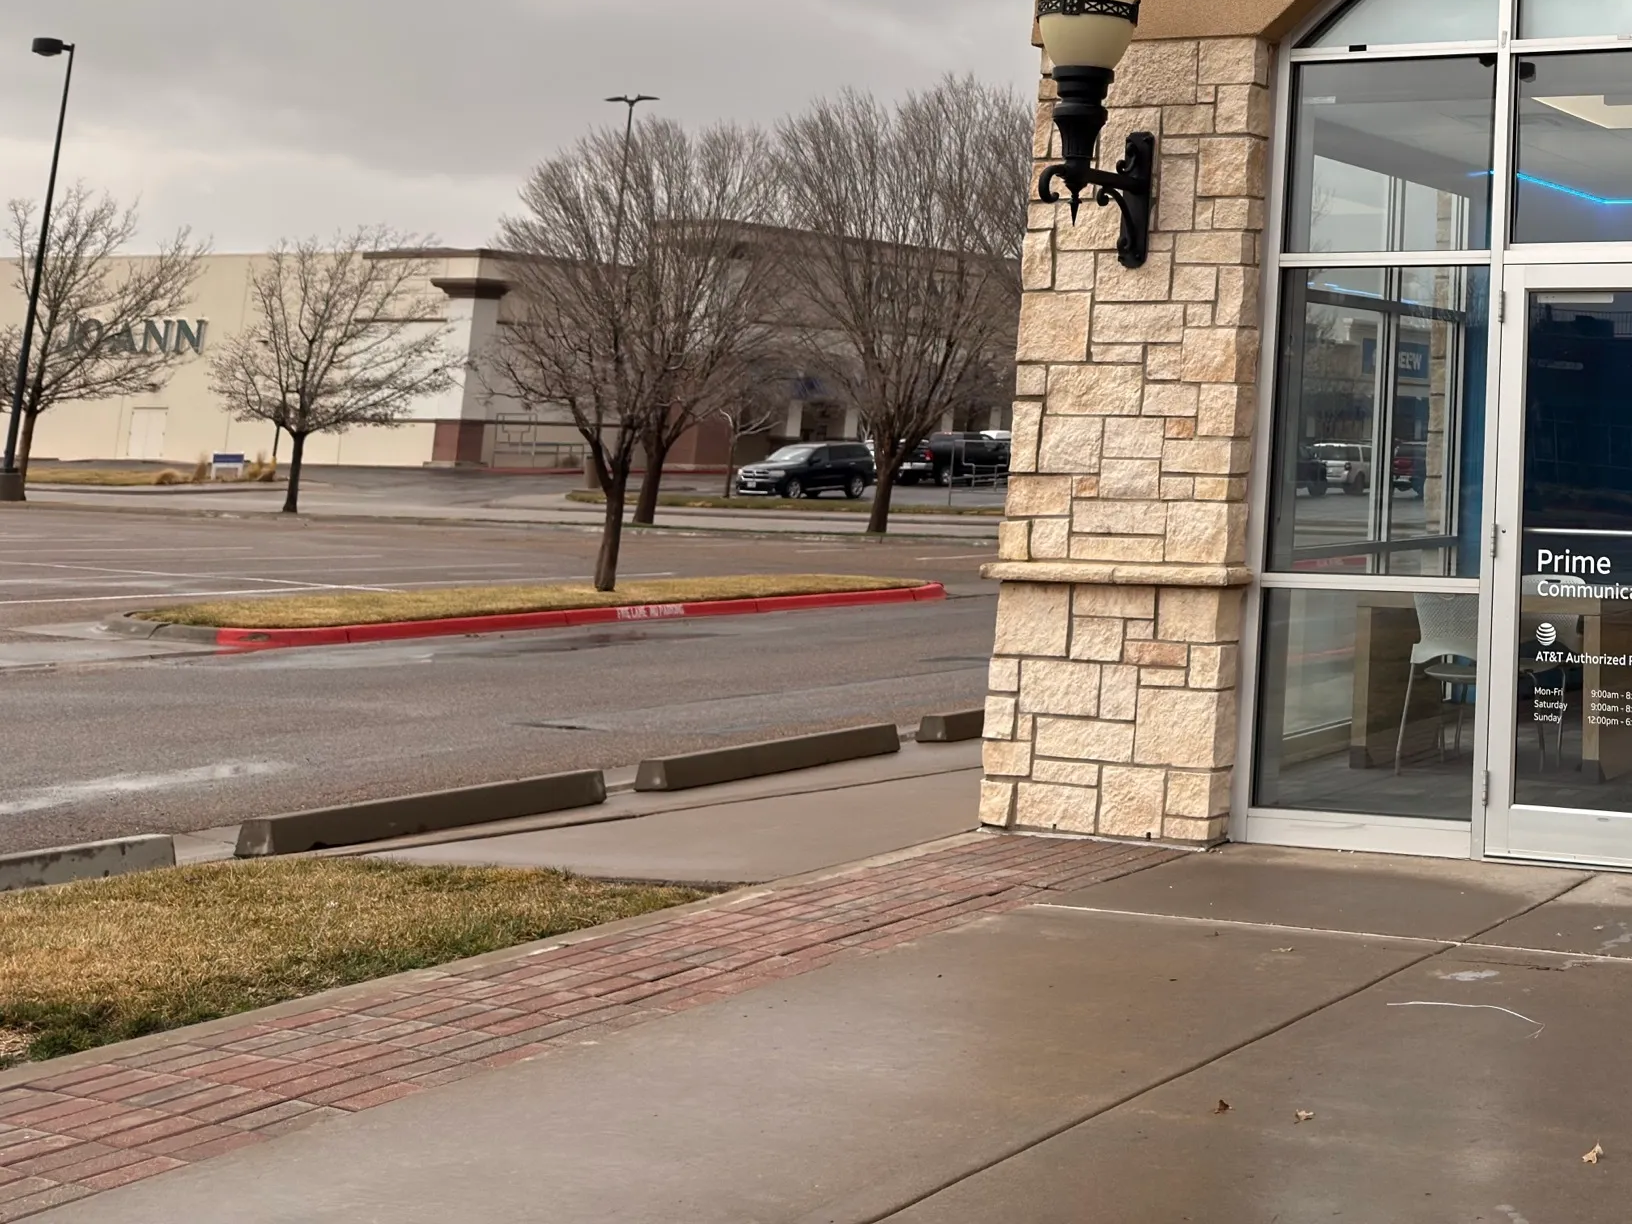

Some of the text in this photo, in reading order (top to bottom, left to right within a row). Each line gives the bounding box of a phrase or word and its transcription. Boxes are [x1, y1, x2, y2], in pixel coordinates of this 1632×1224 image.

[57, 316, 208, 357] JOANN
[1537, 548, 1611, 574] Prime
[1535, 651, 1564, 663] AT&T
[1566, 652, 1626, 666] Authorized
[1534, 686, 1563, 696] Mon-Fri
[1590, 689, 1619, 699] 9:00am
[1534, 699, 1568, 712] Saturday
[1590, 702, 1619, 713] 9:00am
[1533, 712, 1562, 724] Sunday
[1587, 715, 1619, 727] 12:00pm
